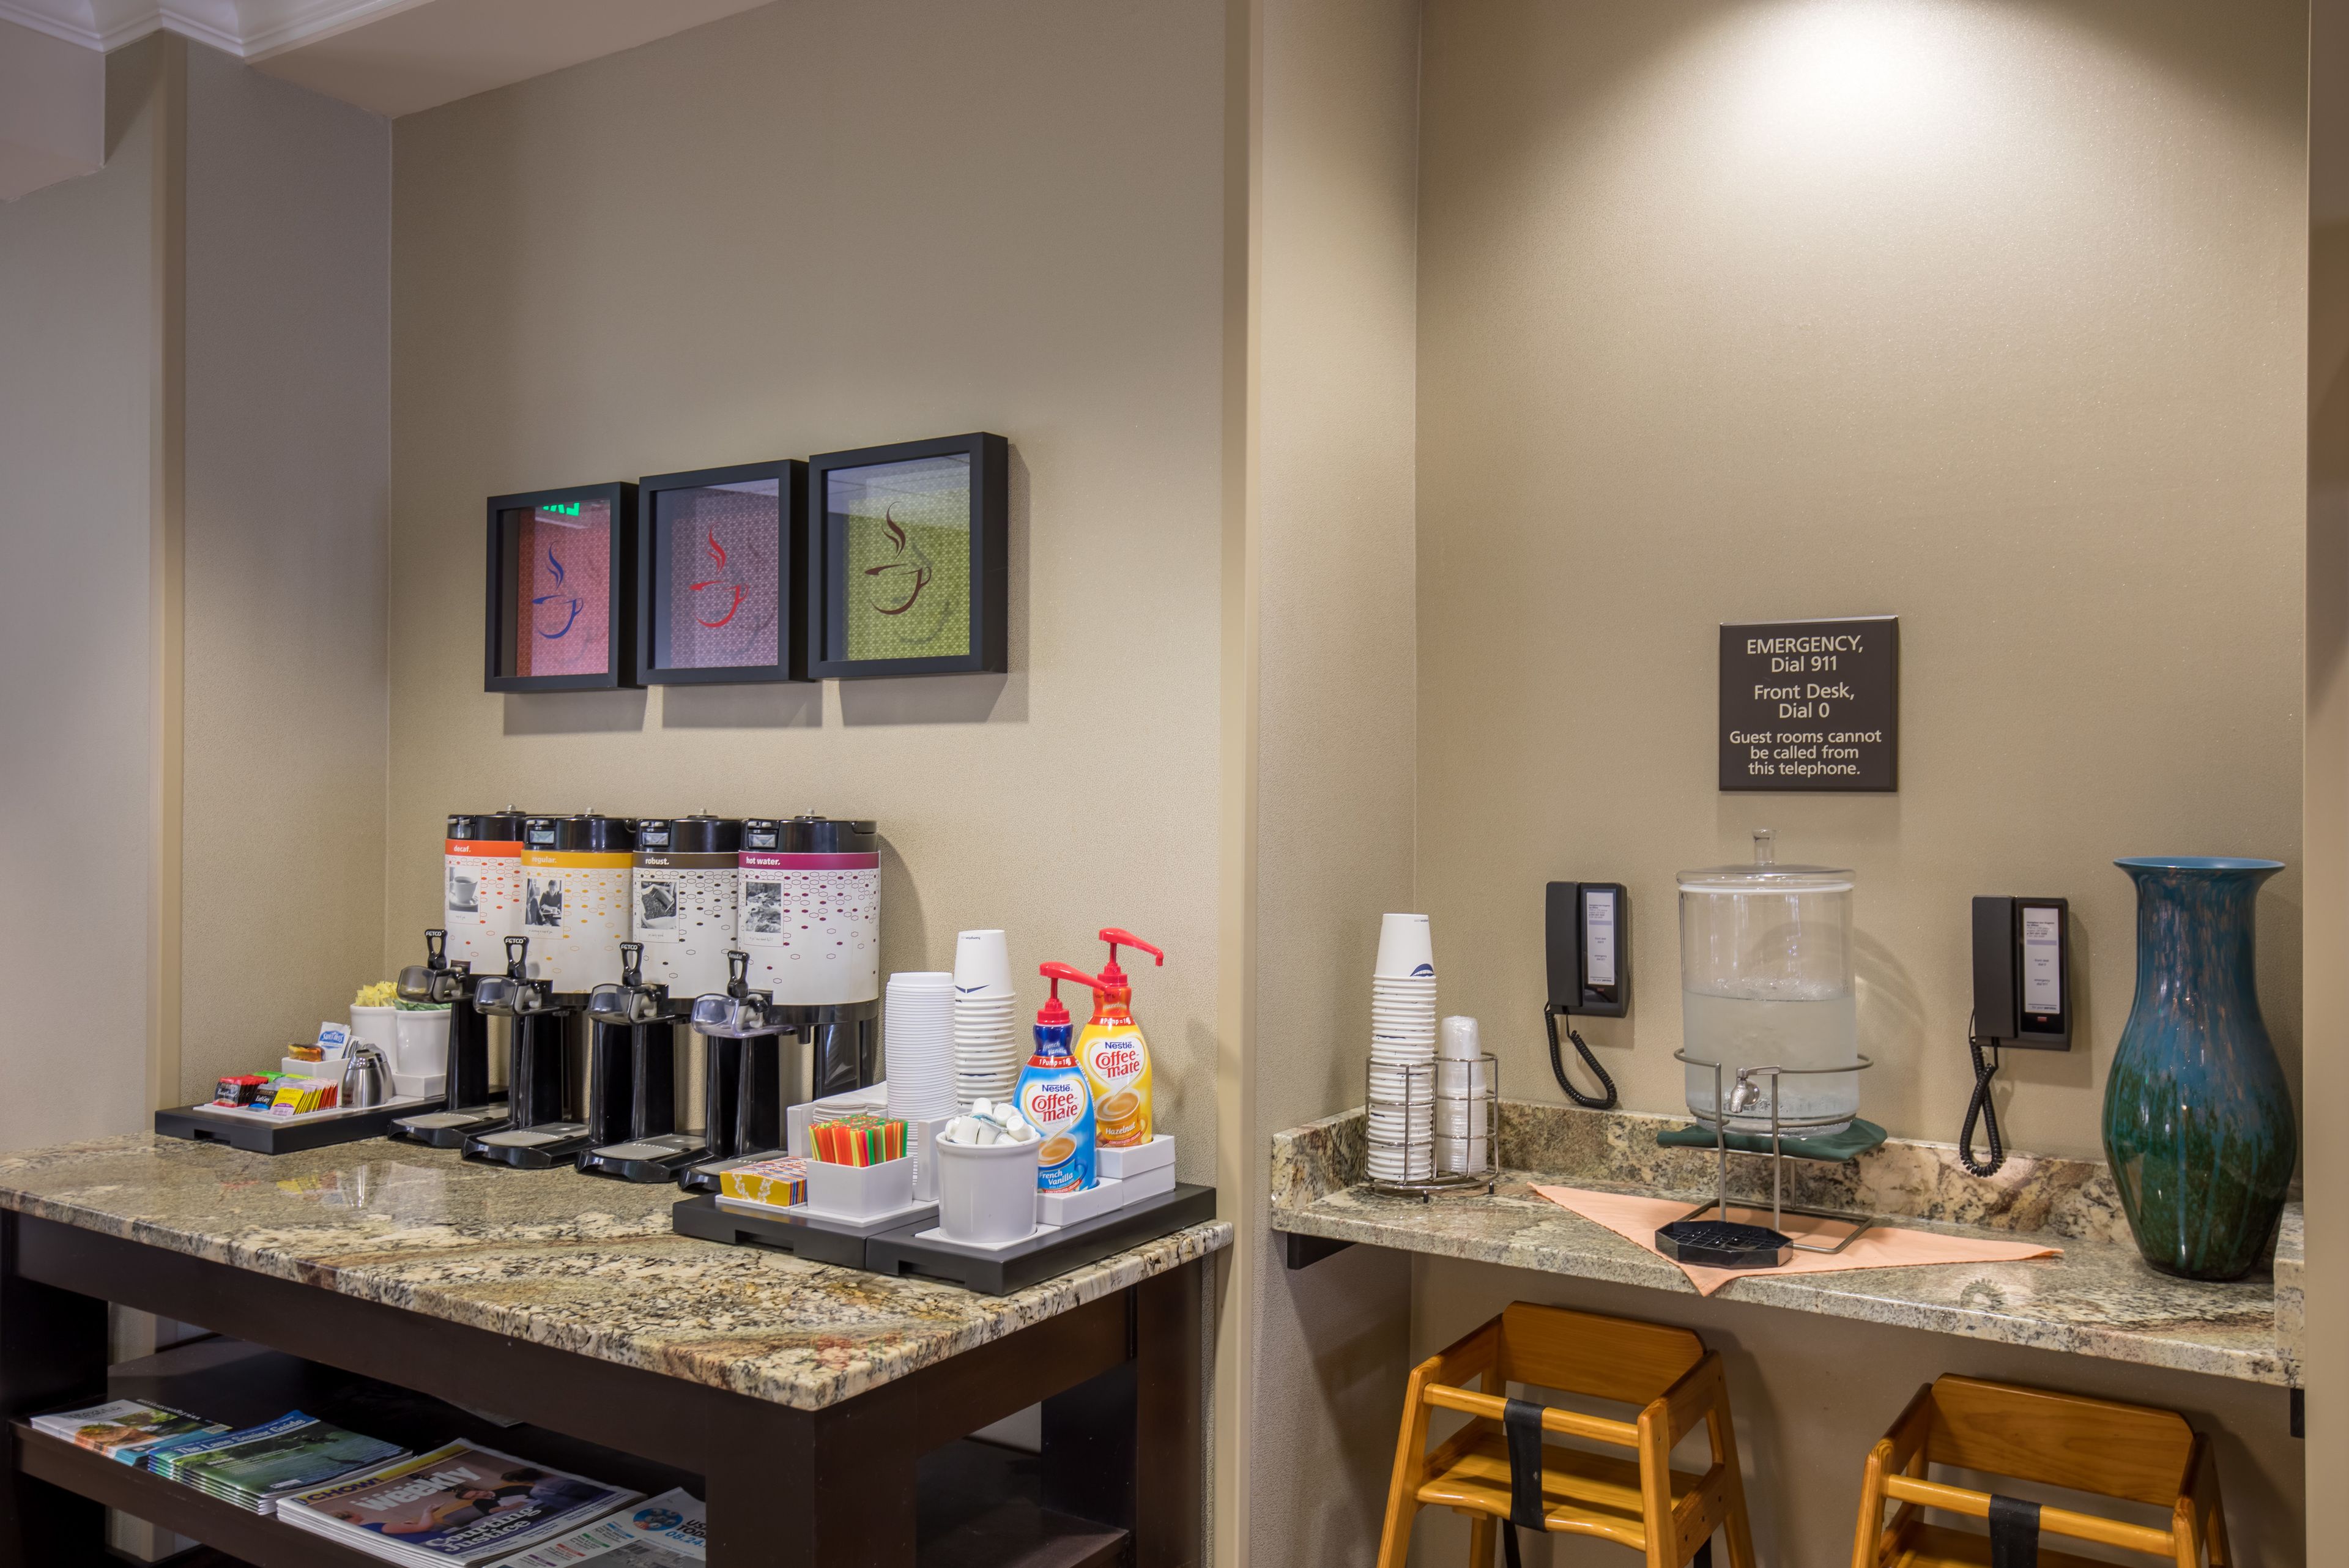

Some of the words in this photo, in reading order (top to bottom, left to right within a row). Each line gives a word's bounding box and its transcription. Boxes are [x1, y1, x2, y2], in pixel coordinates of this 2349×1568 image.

[1747, 635, 1863, 655] EMERGENCY,
[1772, 656, 1805, 672] Dial
[1811, 656, 1836, 672] 911
[1754, 684, 1801, 700] Front
[1807, 682, 1854, 700] Desk,
[1779, 702, 1812, 718] Dial
[1819, 702, 1830, 718] 0
[1730, 731, 1772, 744] Guest
[1777, 732, 1823, 743] rooms
[1828, 730, 1882, 743] cannot
[1751, 746, 1768, 759] be
[1773, 746, 1816, 759] called
[1822, 745, 1858, 759] from
[1748, 762, 1775, 775] this
[1779, 761, 1860, 778] telephone.
[453, 844, 471, 853] decaf.
[532, 856, 557, 866] regular.
[746, 856, 756, 865] hot
[1107, 1060, 1140, 1078] mate
[1042, 1104, 1078, 1122] mate
[1105, 1121, 1136, 1135] Hazelnut
[1039, 1169, 1063, 1179] French
[1048, 1172, 1074, 1186] Vanilla
[174, 1444, 203, 1454] The
[200, 1439, 234, 1449] Lane
[231, 1430, 272, 1443] Senior
[269, 1418, 306, 1433] Guide
[425, 1506, 542, 1547] Courting
[686, 1519, 707, 1530] US
[442, 1520, 531, 1552] Justice
